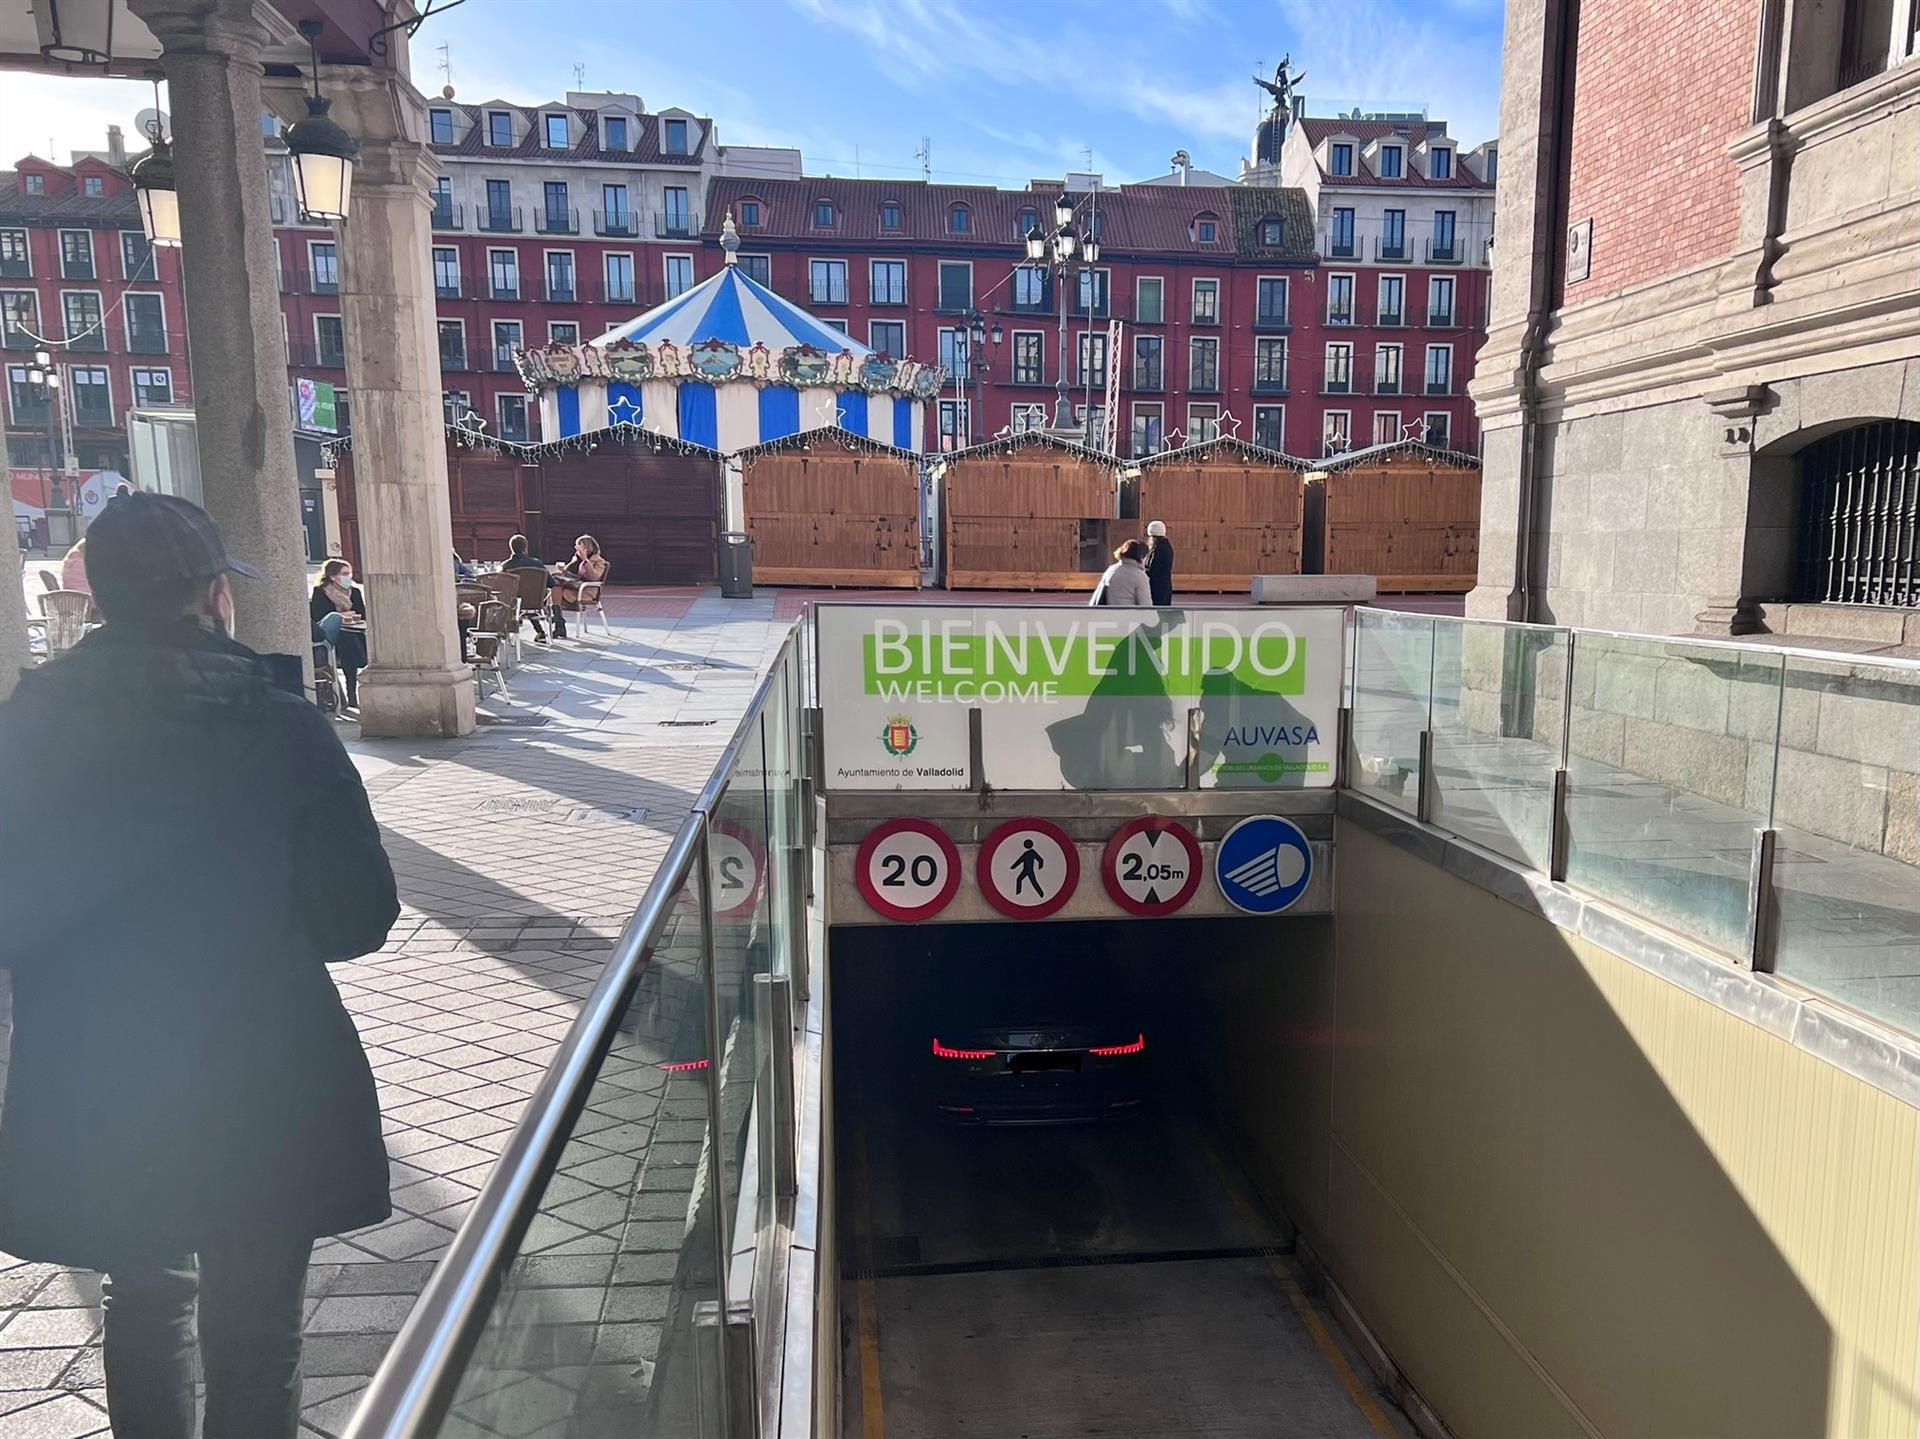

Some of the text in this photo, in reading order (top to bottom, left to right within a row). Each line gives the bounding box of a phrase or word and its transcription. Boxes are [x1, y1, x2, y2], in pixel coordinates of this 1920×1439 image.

[874, 619, 1297, 676] BIENVENIDO
[876, 680, 1059, 704] WELCOME
[1223, 726, 1320, 746] AUVASA
[837, 767, 964, 779] Ayuntamiento de Valladolid
[882, 854, 938, 887] 20
[1122, 853, 1184, 882] 2,05m
